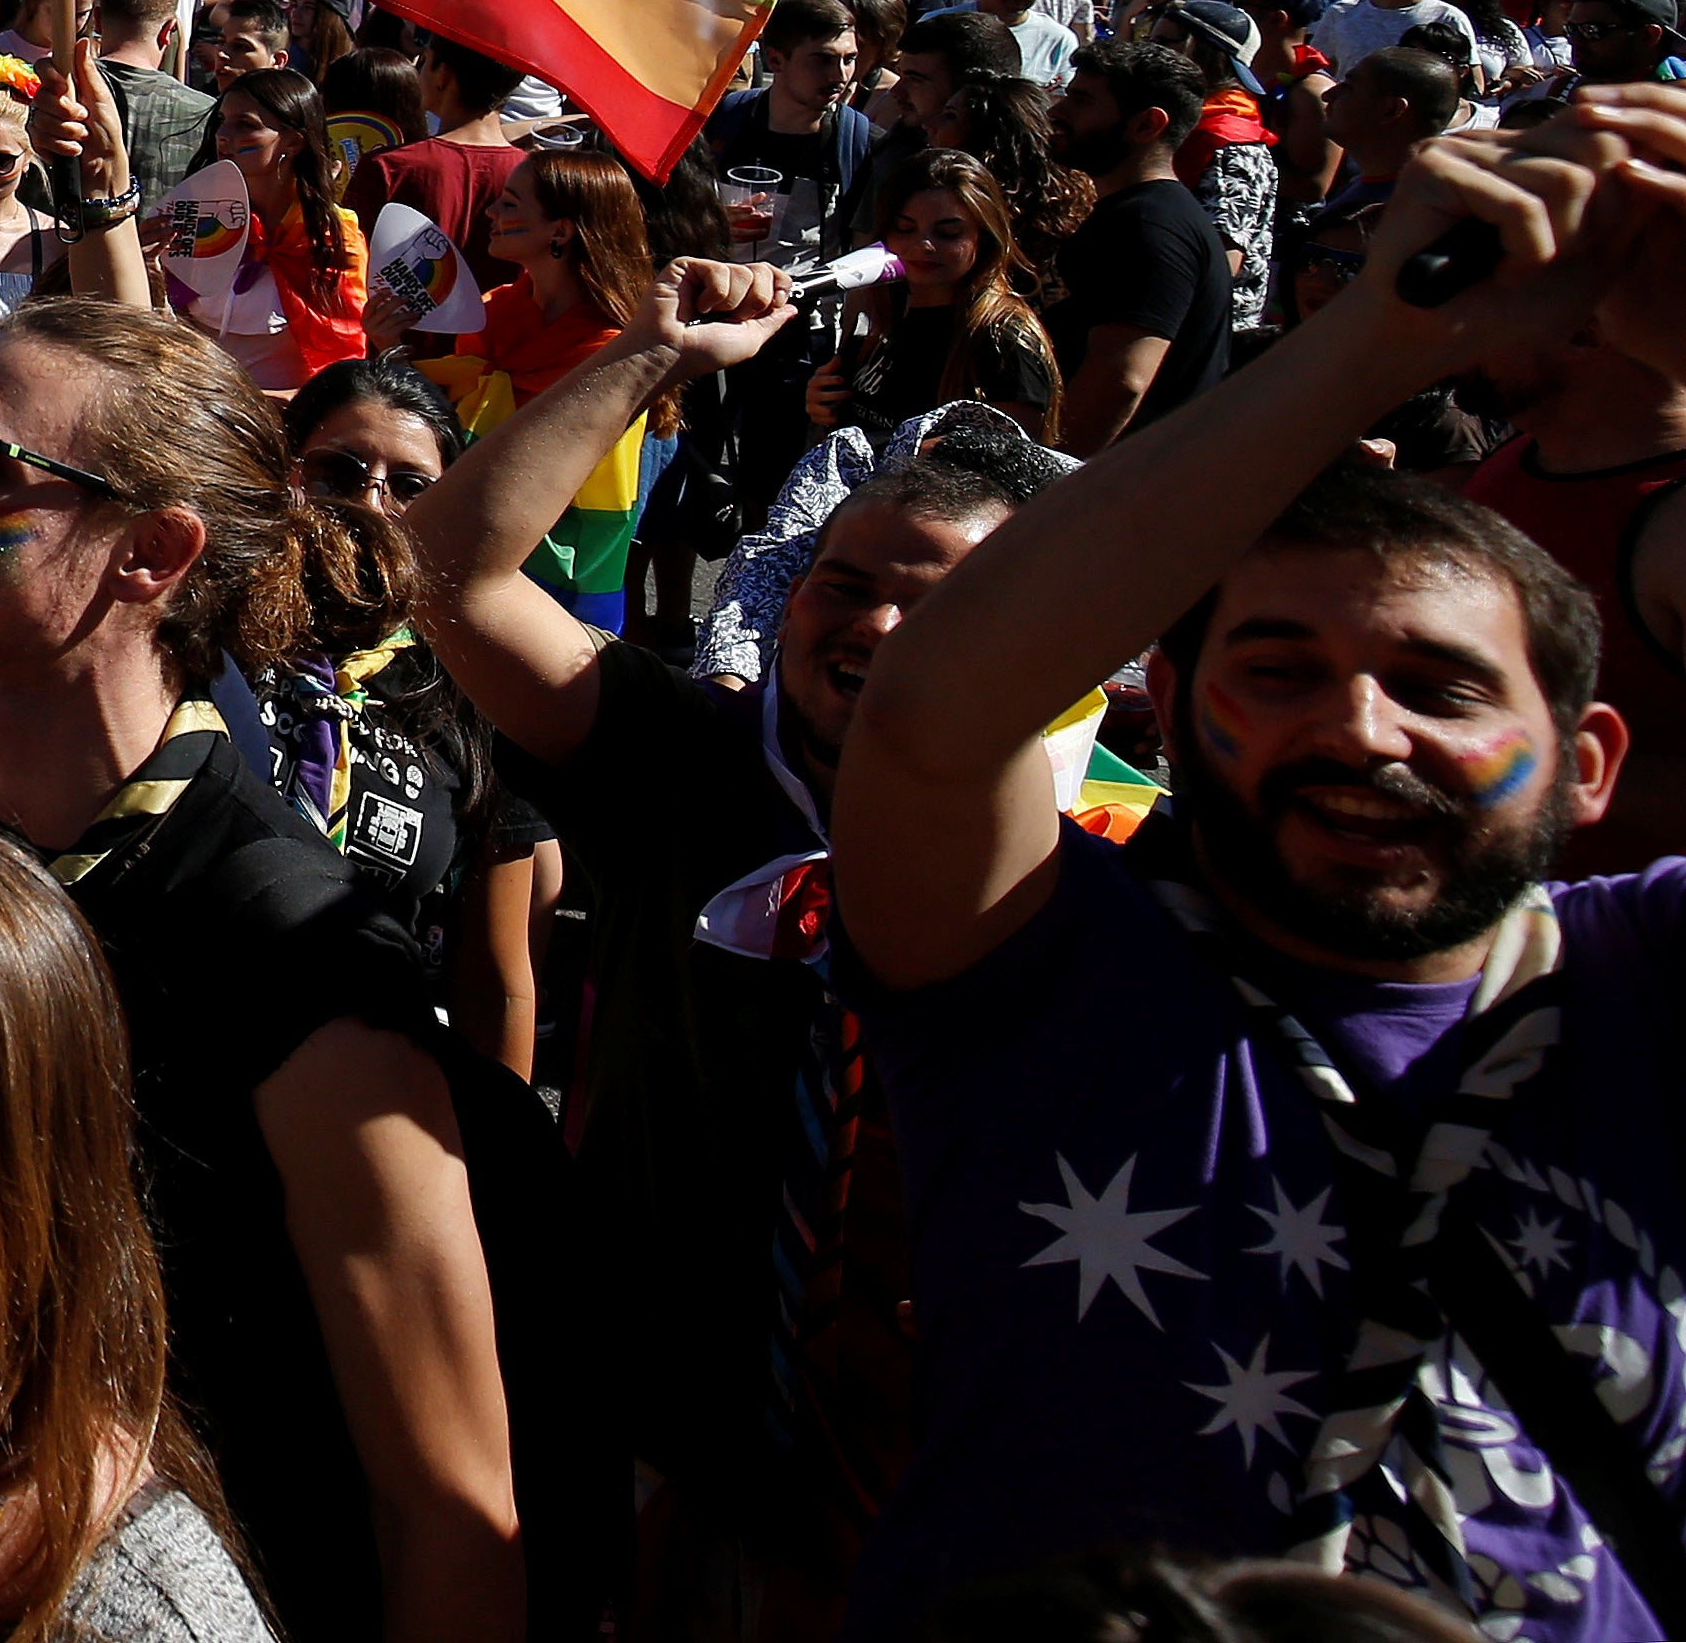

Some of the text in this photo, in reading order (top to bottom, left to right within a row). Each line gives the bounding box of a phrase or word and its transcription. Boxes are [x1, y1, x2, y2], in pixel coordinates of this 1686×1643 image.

[380, 265, 403, 289] OUR
[390, 257, 438, 312] HANDS OFF
